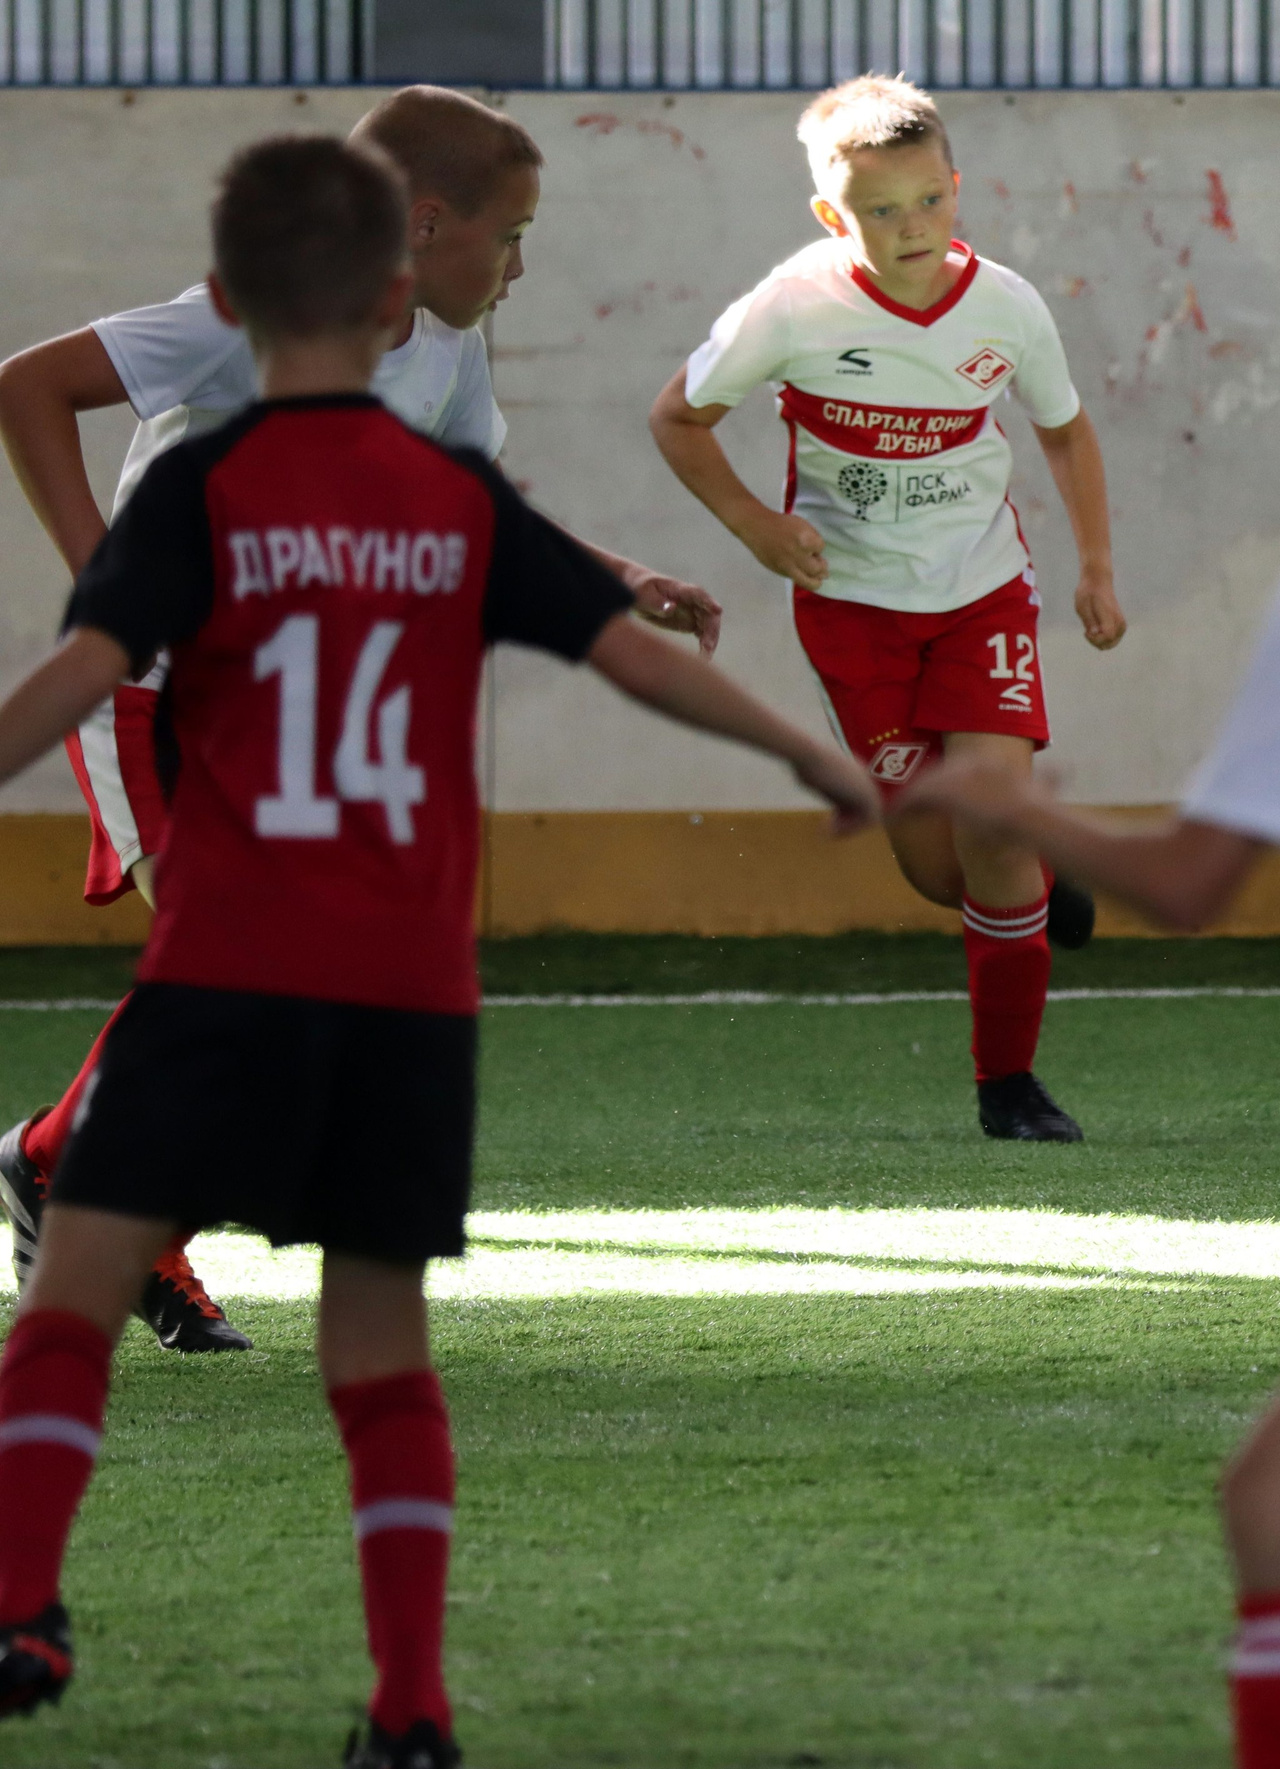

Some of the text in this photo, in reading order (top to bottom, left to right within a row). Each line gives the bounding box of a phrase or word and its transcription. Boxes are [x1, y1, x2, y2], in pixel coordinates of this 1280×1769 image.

[823, 403, 974, 432] СПАРТАК ЮНИ
[874, 432, 943, 453] ДУБНА
[905, 484, 972, 507] ФАРМА
[906, 472, 947, 492] ПСК
[230, 527, 467, 600] ДРАГУНОВ
[987, 633, 1034, 681] 12
[254, 614, 426, 845] 14
